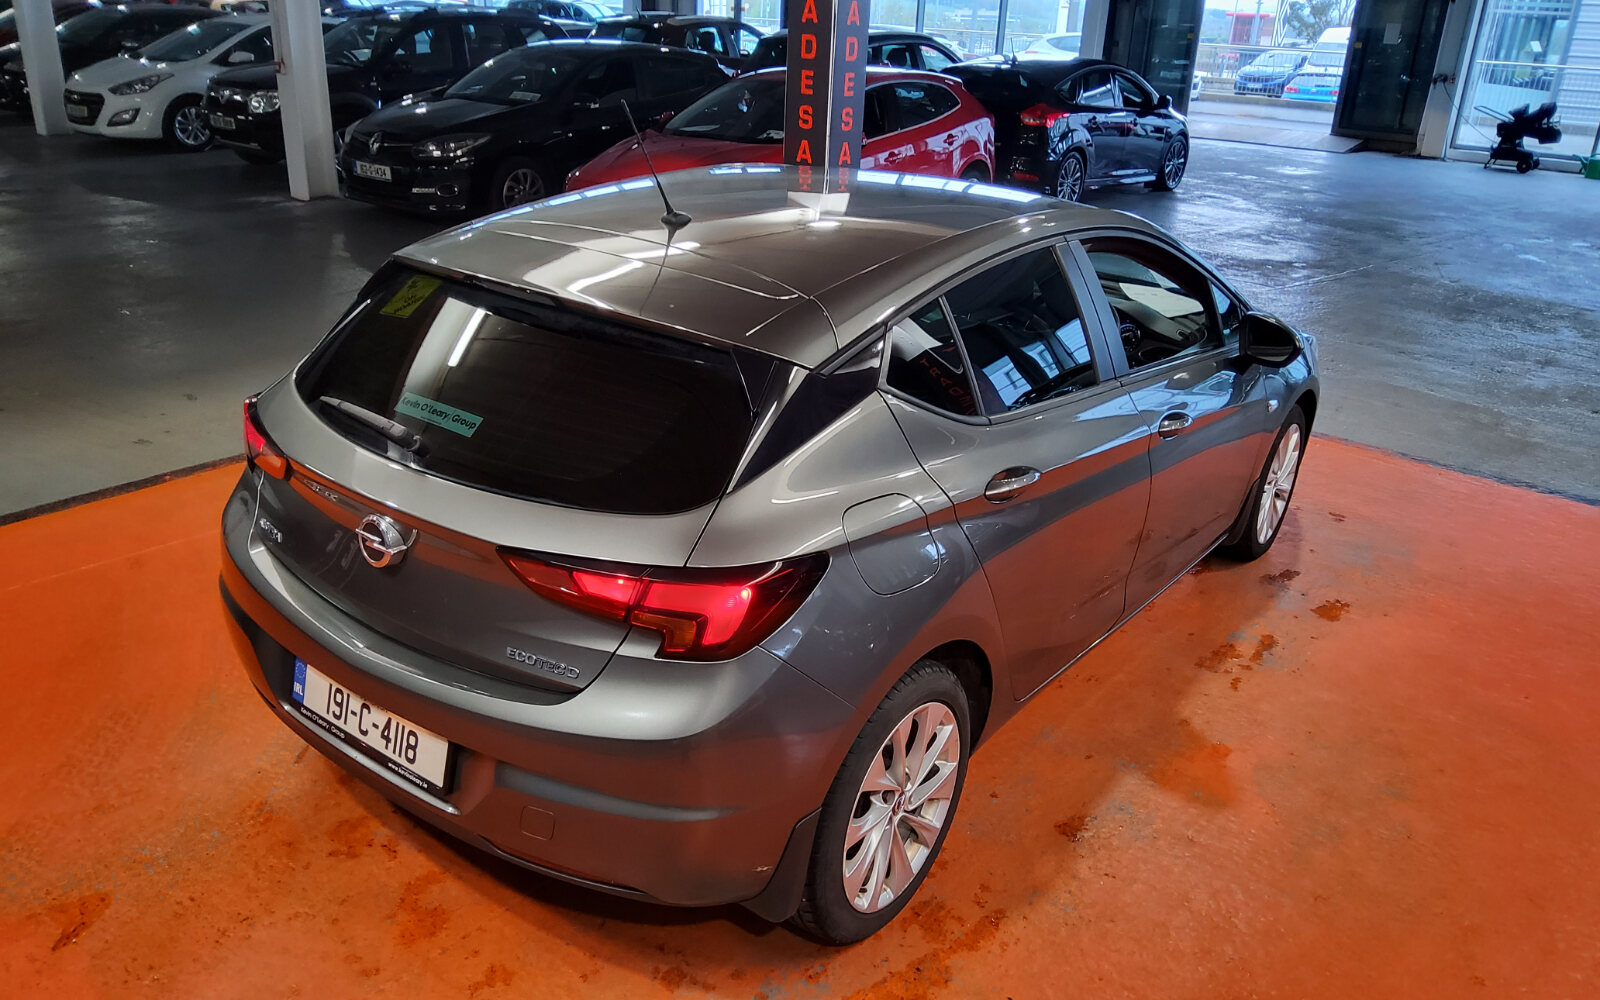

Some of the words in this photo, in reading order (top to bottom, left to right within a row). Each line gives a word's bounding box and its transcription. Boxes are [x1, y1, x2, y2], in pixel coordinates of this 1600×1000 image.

[796, 0, 818, 164] ADESA
[838, 0, 860, 165] ADESA
[401, 396, 421, 409] Kevin
[420, 403, 451, 420] O'Leary
[451, 414, 477, 430] Group
[293, 681, 304, 696] IRL
[506, 646, 567, 676] ECOTEC
[567, 666, 581, 680] D
[326, 682, 419, 765] 191-C-4118
